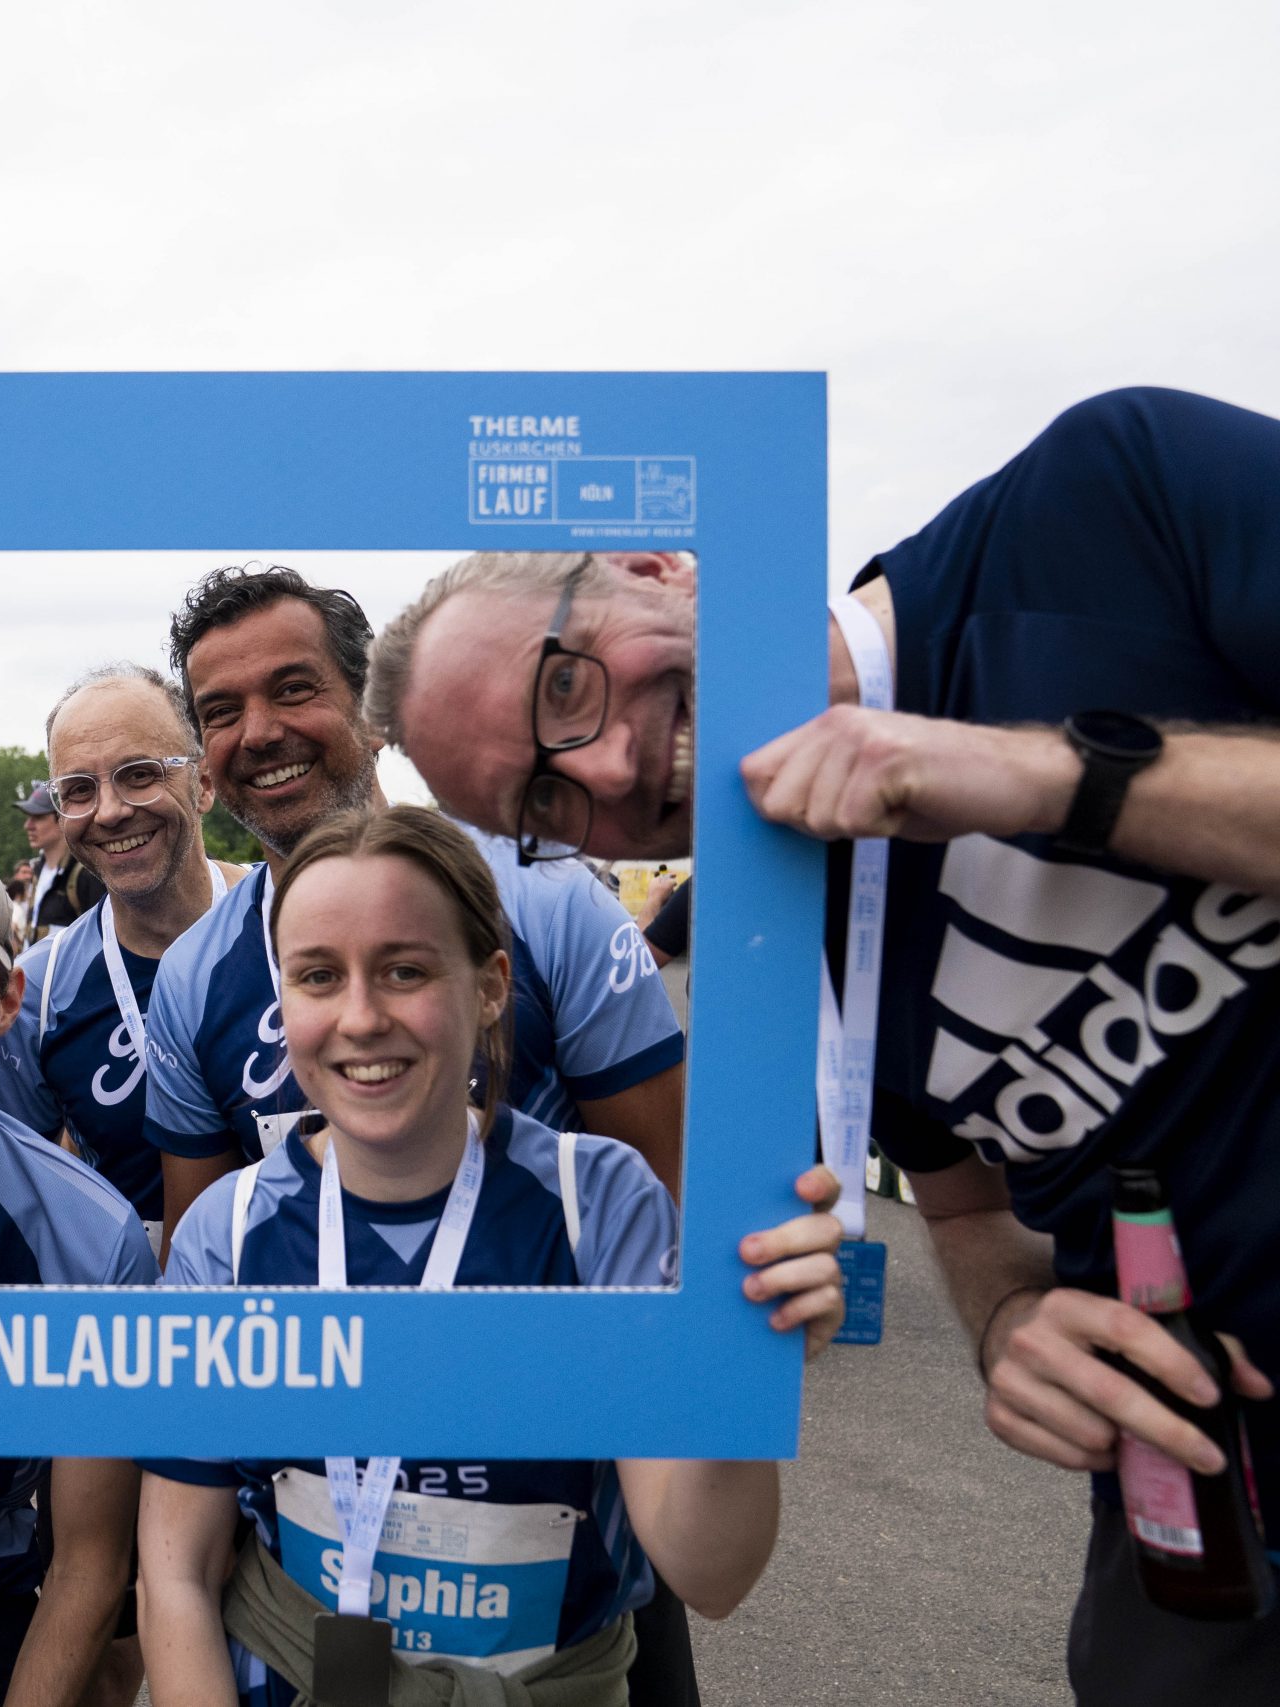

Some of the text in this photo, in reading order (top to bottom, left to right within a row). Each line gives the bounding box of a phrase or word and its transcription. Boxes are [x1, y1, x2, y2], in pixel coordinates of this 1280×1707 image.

[469, 415, 581, 437] THERME
[469, 440, 582, 457] EUSKIRCHEN
[478, 464, 548, 484] FIRMEN
[478, 487, 548, 515] LAUF
[579, 482, 614, 502] KÖLN
[608, 921, 659, 994] Fo
